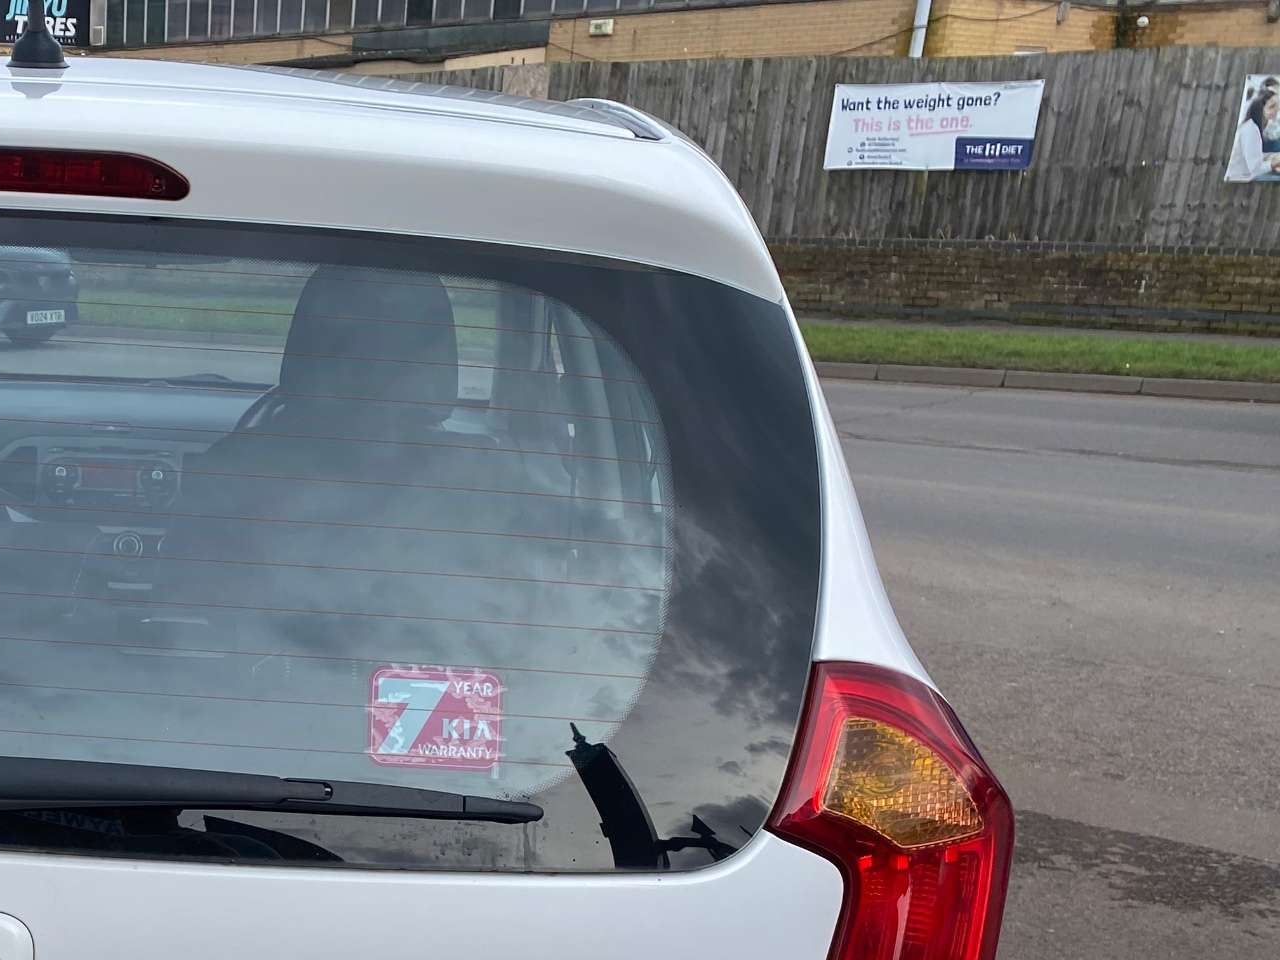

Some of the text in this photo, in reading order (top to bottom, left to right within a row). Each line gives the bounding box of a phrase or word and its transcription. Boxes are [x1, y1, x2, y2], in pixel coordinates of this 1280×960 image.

[15, 15, 76, 36] TRES
[841, 92, 1001, 112] Want the weight gone?
[853, 117, 883, 133] This
[886, 117, 901, 132] is
[906, 115, 933, 131] the
[966, 144, 984, 155] THE
[1001, 145, 1024, 155] DIET
[452, 681, 493, 697] YEAR
[377, 677, 451, 754] 7
[441, 718, 492, 742] KIA
[418, 743, 493, 760] WARRANTY
